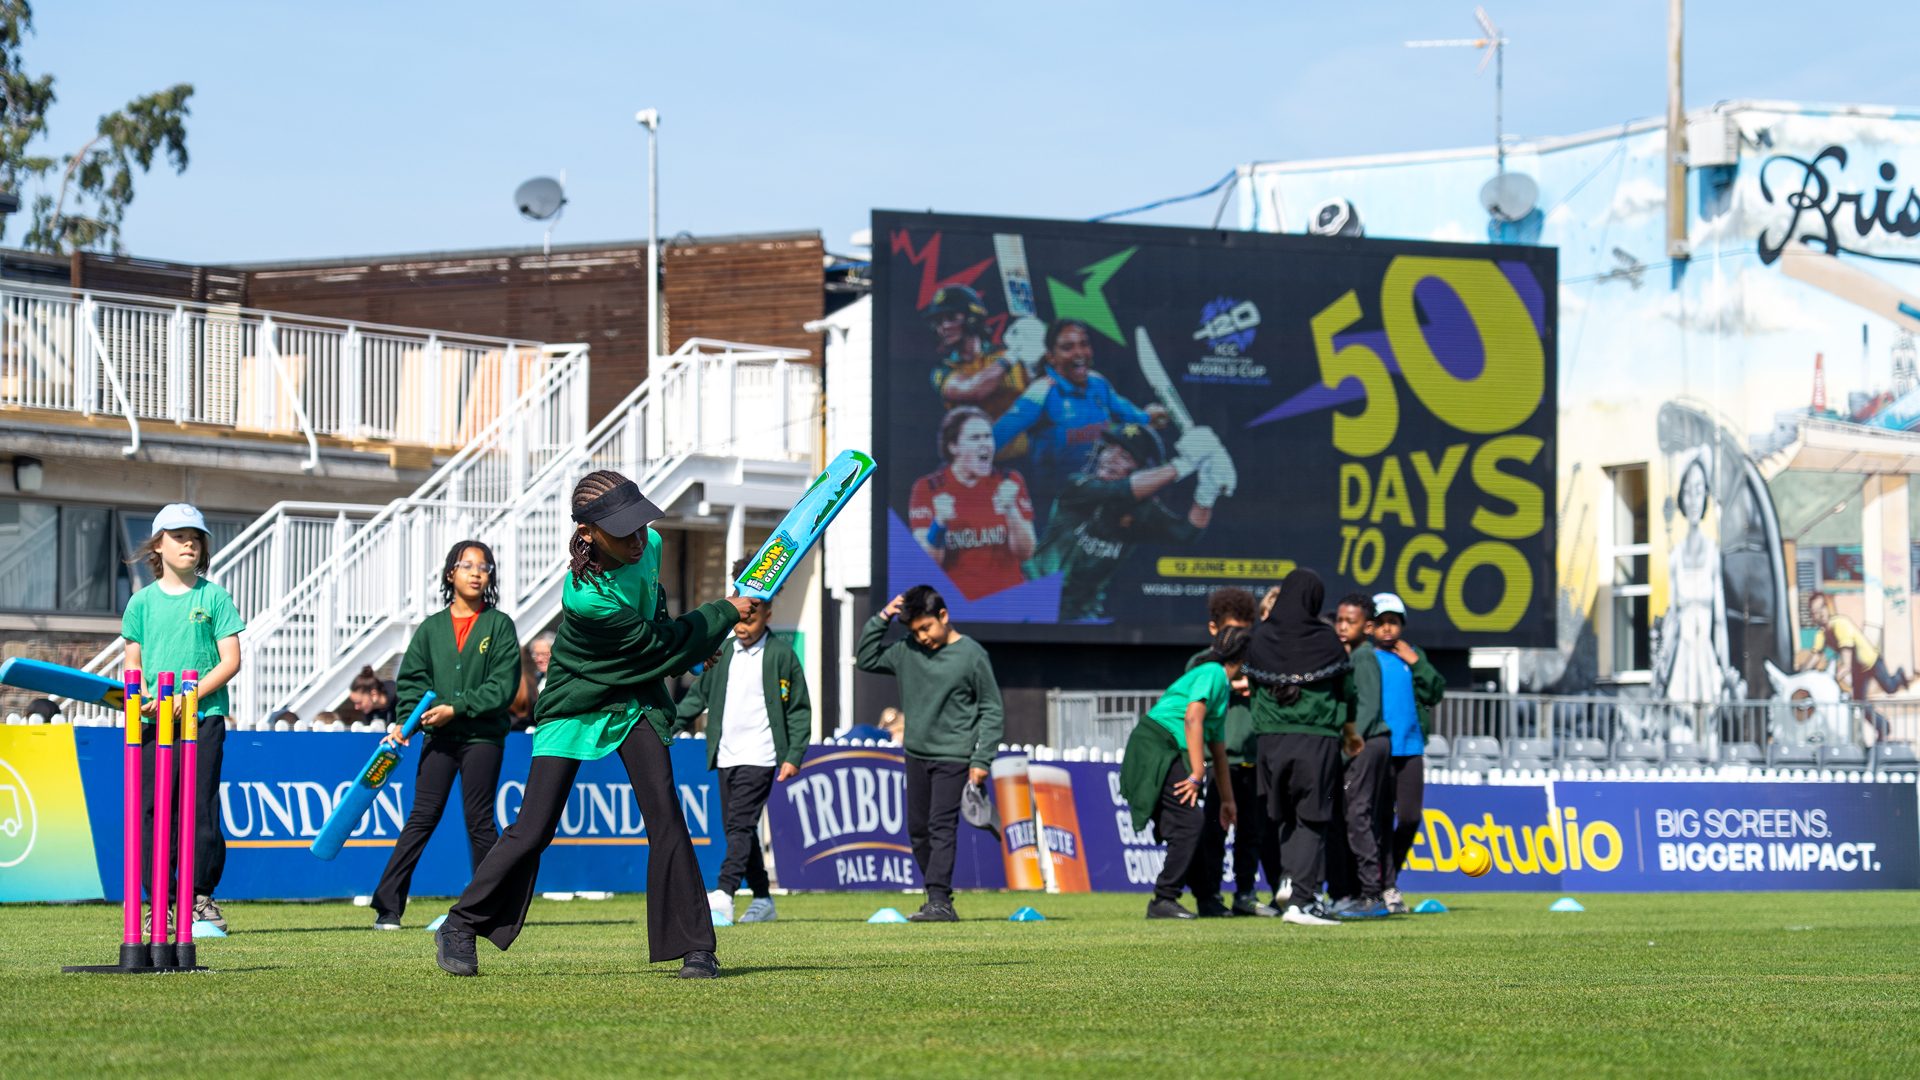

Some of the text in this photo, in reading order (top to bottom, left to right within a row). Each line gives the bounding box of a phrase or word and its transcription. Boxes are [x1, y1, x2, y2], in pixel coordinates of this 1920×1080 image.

[1188, 362, 1266, 378] WORLD CUP
[1310, 254, 1545, 458] 50
[1339, 434, 1545, 540] DAYS
[944, 524, 1007, 550] ENGLAND
[764, 551, 790, 583] CRICKET
[1338, 526, 1533, 632] TO GO
[1142, 583, 1184, 596] WORLD
[1185, 584, 1207, 597] CUP
[219, 781, 405, 838] UNDON
[497, 780, 710, 836] GUNDN
[786, 767, 907, 849] TRIBU
[1656, 808, 1832, 838] BIG SCREENS.
[1402, 806, 1623, 875] EDstudio
[1658, 842, 1882, 872] BIGGER IMPACT.
[836, 855, 914, 885] PALE ALE
